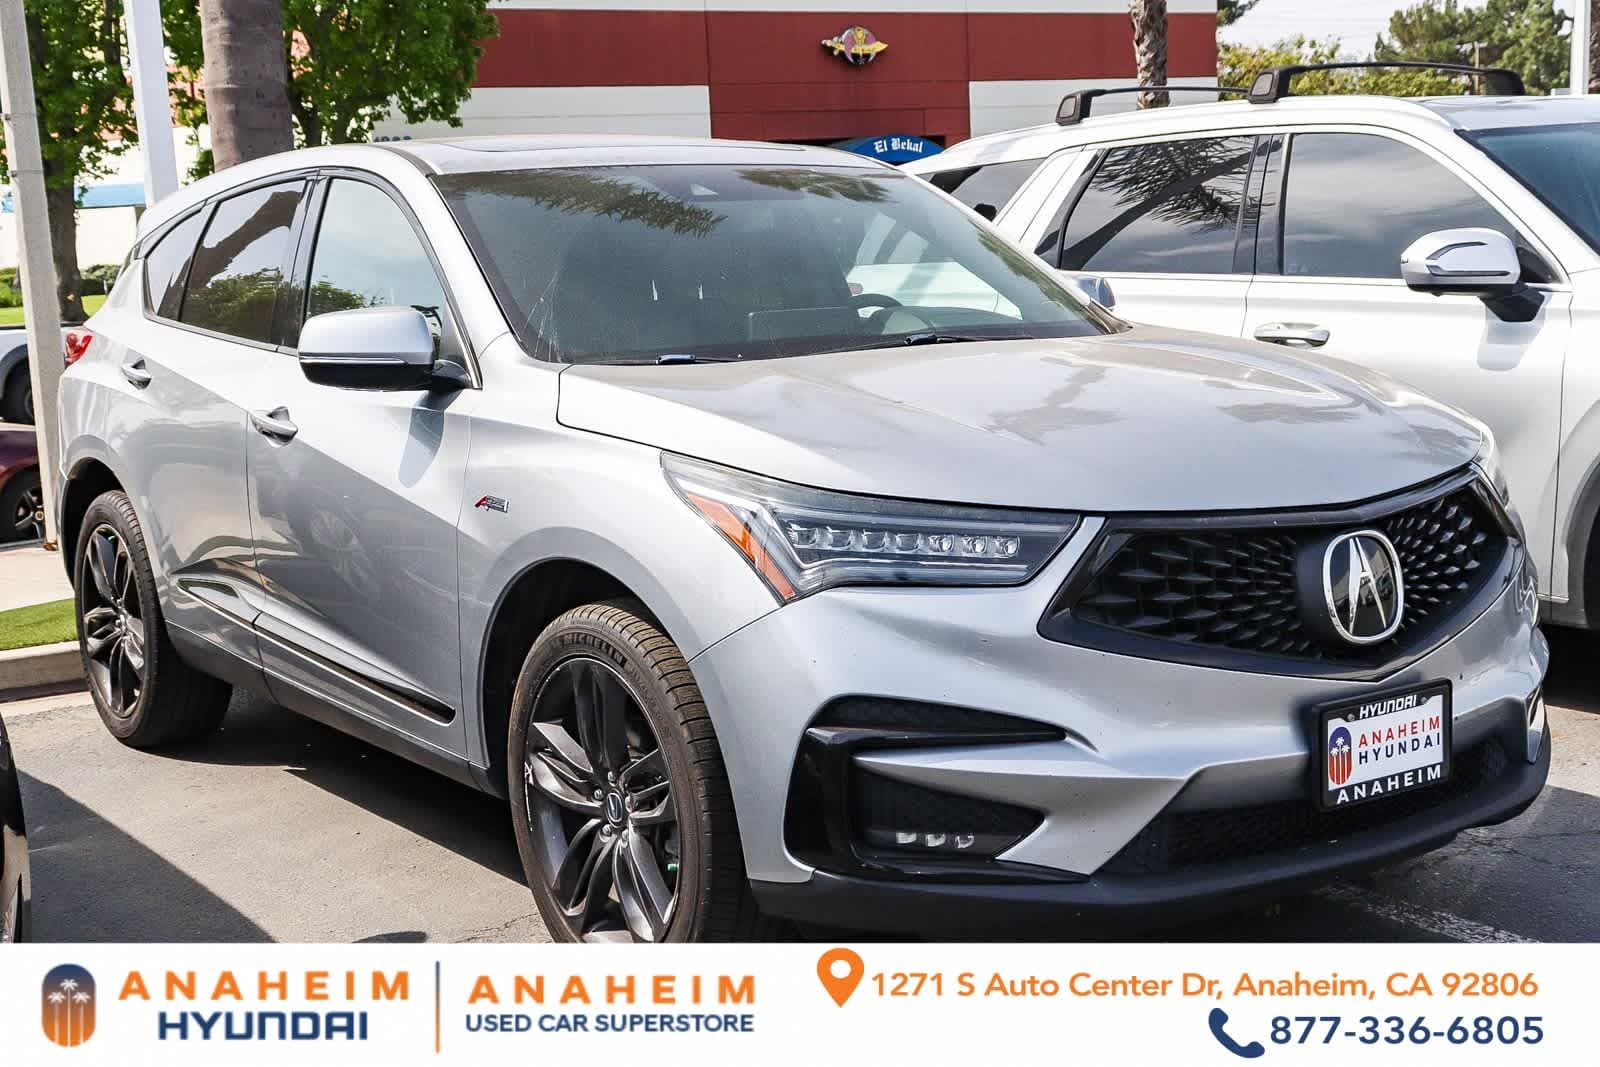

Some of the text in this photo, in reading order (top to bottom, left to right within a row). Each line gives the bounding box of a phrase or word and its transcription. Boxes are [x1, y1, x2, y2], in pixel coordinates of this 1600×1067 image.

[873, 139, 888, 153] El
[563, 632, 624, 664] MICHELIN
[1359, 694, 1417, 719] HYUNDAI
[1358, 715, 1440, 748] ANAHEIM
[1358, 732, 1440, 765] HYUNDAI
[1336, 764, 1441, 805] ANAHEIM
